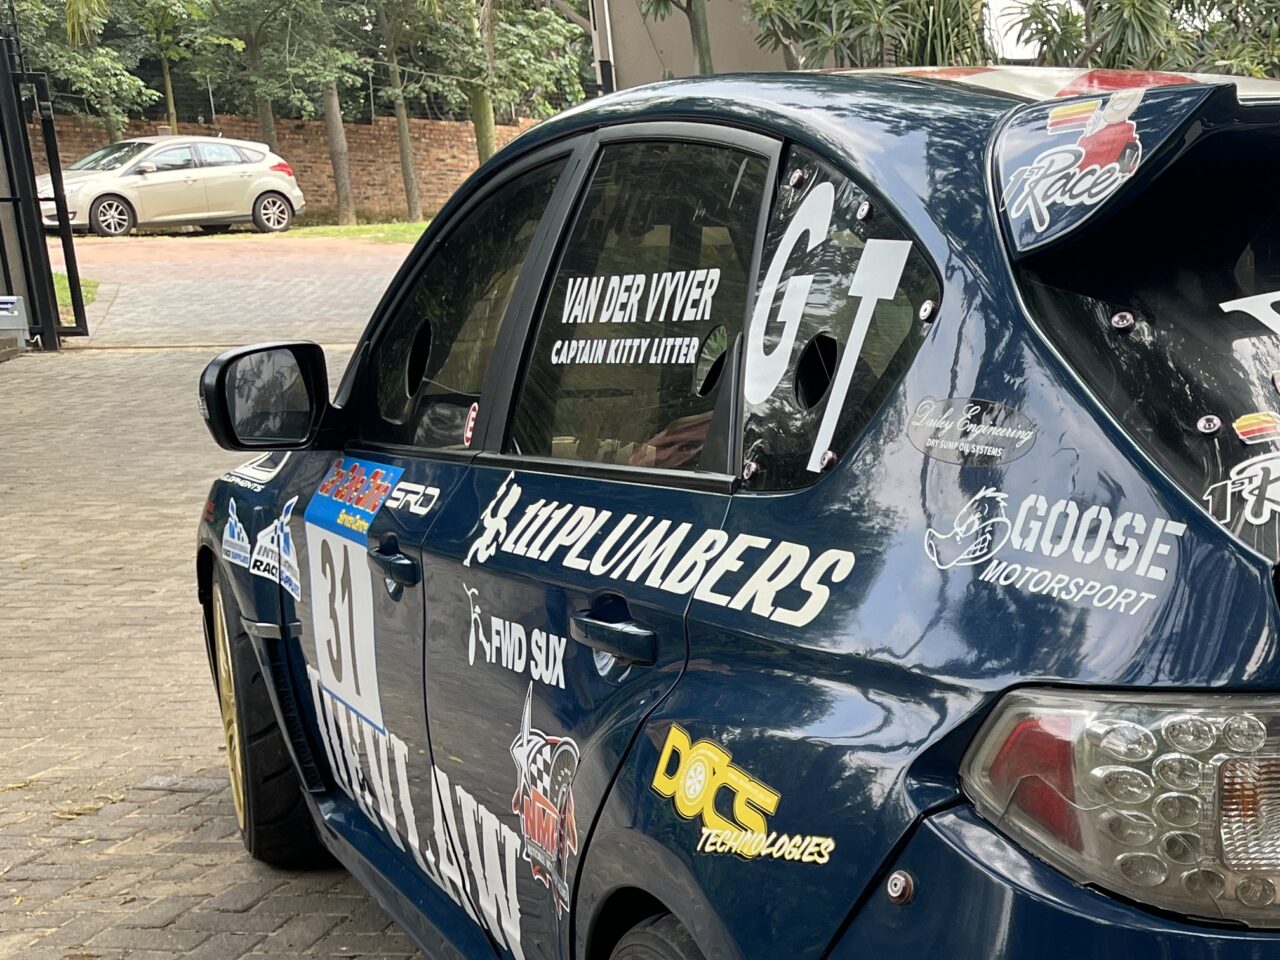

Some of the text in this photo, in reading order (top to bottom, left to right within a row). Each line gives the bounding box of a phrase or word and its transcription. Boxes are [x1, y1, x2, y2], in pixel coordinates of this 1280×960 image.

[1012, 145, 1120, 231] Race
[562, 268, 721, 325] VAN DER VYVER
[744, 182, 913, 473] GT
[551, 336, 700, 365] CAPTAIN KITTY LITTER
[926, 437, 1003, 457] DRY SUMP OIL SYSTEMS
[956, 403, 1033, 448] Engineering
[384, 481, 441, 515] SRD
[502, 497, 856, 628] 111PLUMBERS
[1011, 493, 1188, 581] GOOSE
[320, 538, 362, 697] 31
[978, 559, 1157, 615] MOTORSPORT
[490, 616, 567, 690] FWD SUX
[651, 723, 783, 858] DOCS
[697, 827, 836, 865] TECHNOLOGIES
